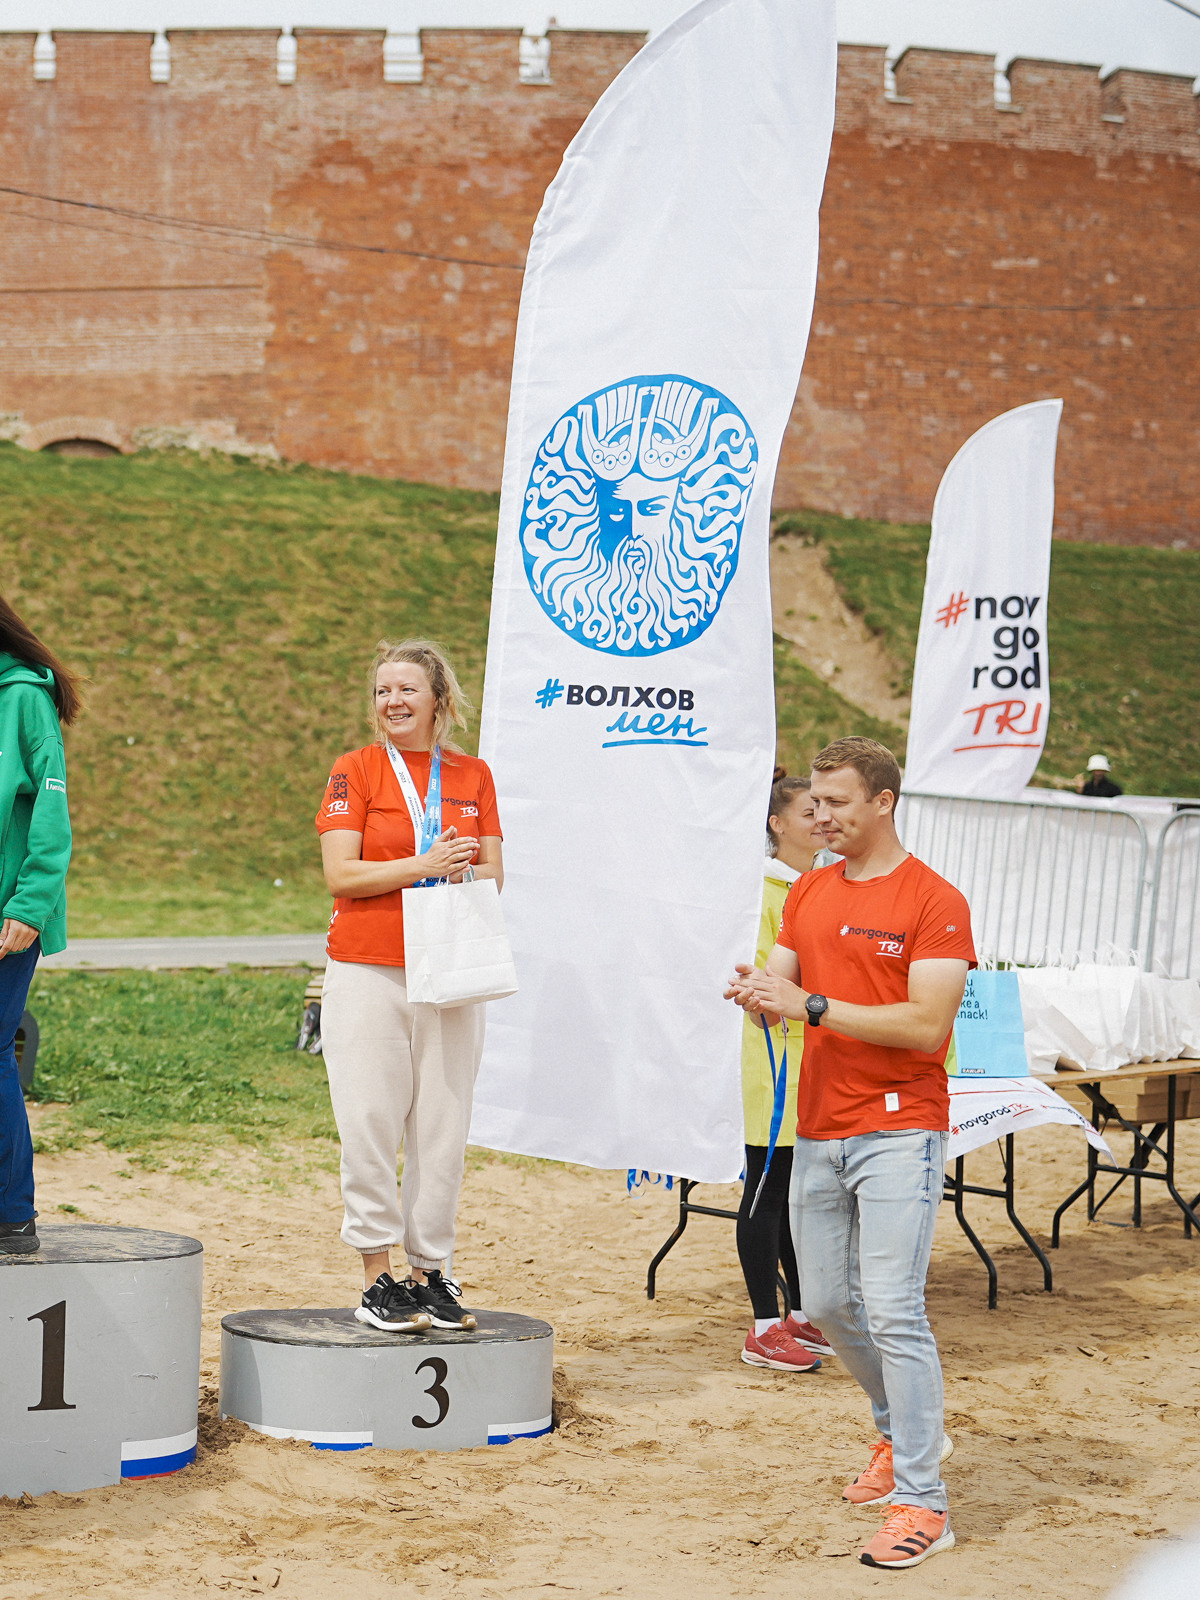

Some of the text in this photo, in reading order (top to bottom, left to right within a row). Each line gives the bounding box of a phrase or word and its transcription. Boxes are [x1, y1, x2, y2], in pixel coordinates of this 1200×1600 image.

[936, 591, 1041, 628] #nov
[993, 626, 1040, 660] go
[972, 652, 1041, 689] rod
[535, 678, 695, 711] #ВОЛХОВ
[606, 711, 707, 737] мен
[963, 700, 1042, 735] TRI
[330, 788, 348, 800] rod
[333, 781, 348, 791] go
[328, 800, 348, 813] TRI
[840, 925, 906, 943] #novgorod
[878, 941, 904, 954] TRI
[951, 1105, 1010, 1135] #novgorod
[27, 1300, 76, 1411] 1
[412, 1356, 450, 1429] 3
